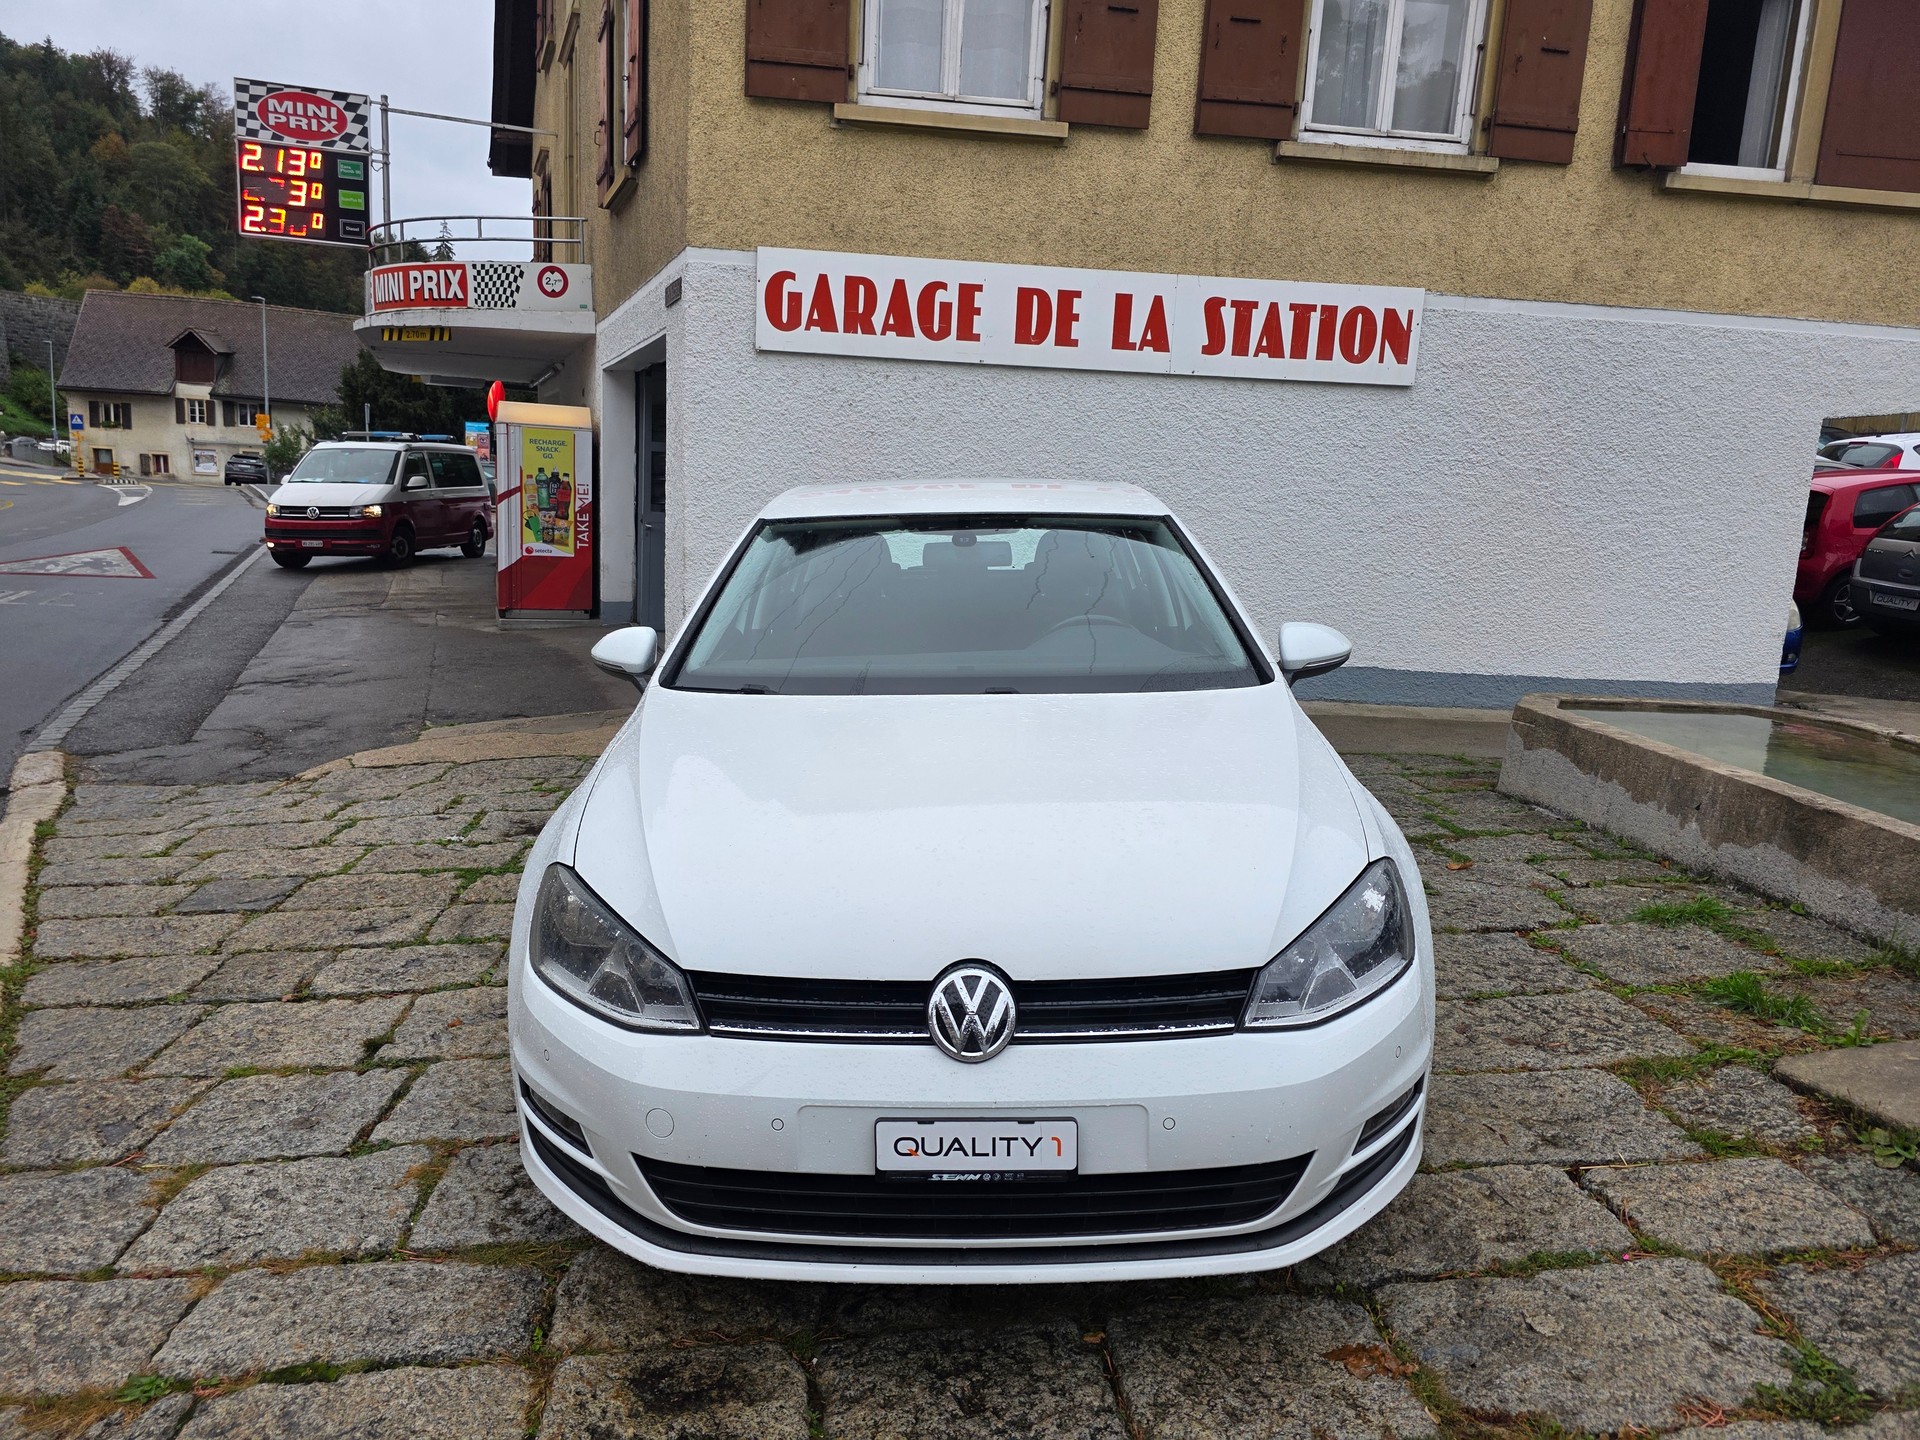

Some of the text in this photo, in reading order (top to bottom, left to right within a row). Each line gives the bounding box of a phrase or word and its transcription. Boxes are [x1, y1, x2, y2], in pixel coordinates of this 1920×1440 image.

[267, 98, 338, 120] MINI
[268, 113, 340, 134] PRIX
[374, 269, 465, 304] MINI PRIX
[764, 270, 1414, 365] GARAGE DE LA STATION
[529, 438, 568, 447] RECHARGE.
[577, 483, 589, 549] TAKE ME!
[927, 1173, 982, 1181] SENN
